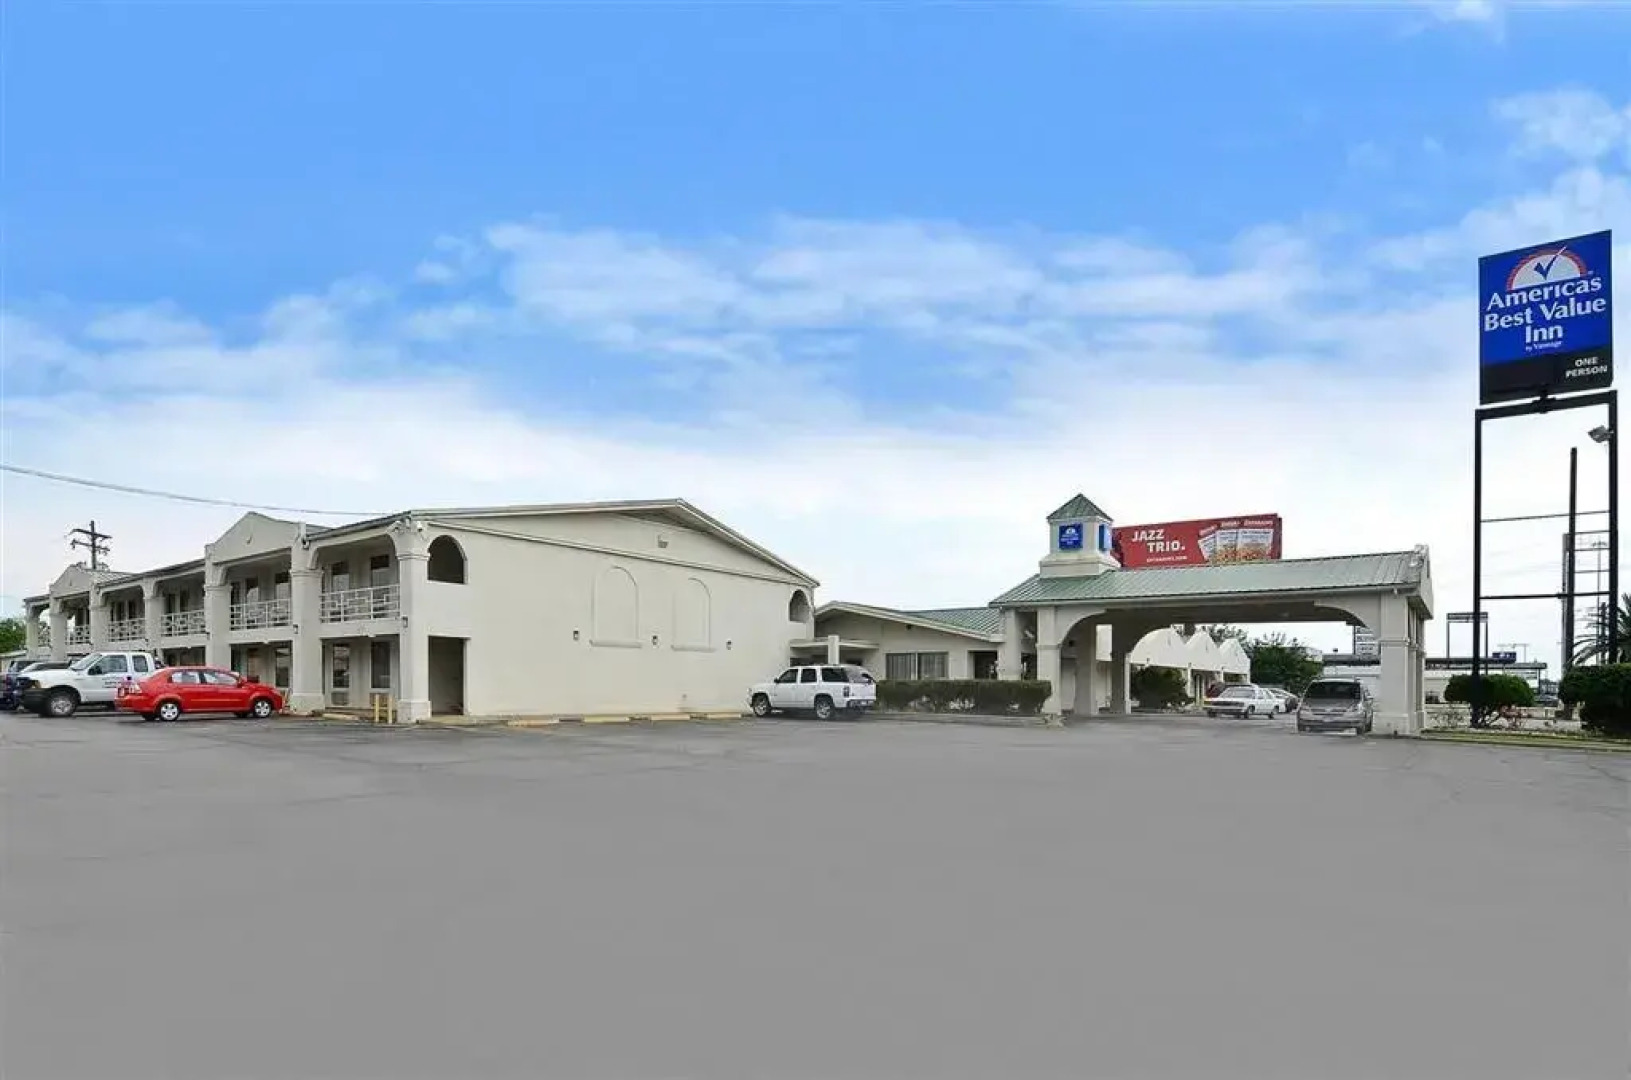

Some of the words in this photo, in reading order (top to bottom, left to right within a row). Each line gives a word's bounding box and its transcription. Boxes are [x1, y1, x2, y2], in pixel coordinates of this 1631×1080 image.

[1487, 276, 1602, 311] Americas
[1484, 307, 1534, 332] Best
[1539, 297, 1606, 321] Value
[1525, 324, 1563, 343] Inn
[1574, 357, 1598, 367] ONE
[1565, 365, 1608, 378] PERSON
[1132, 528, 1165, 542] JAZZ
[1146, 540, 1186, 553] TRIO.
